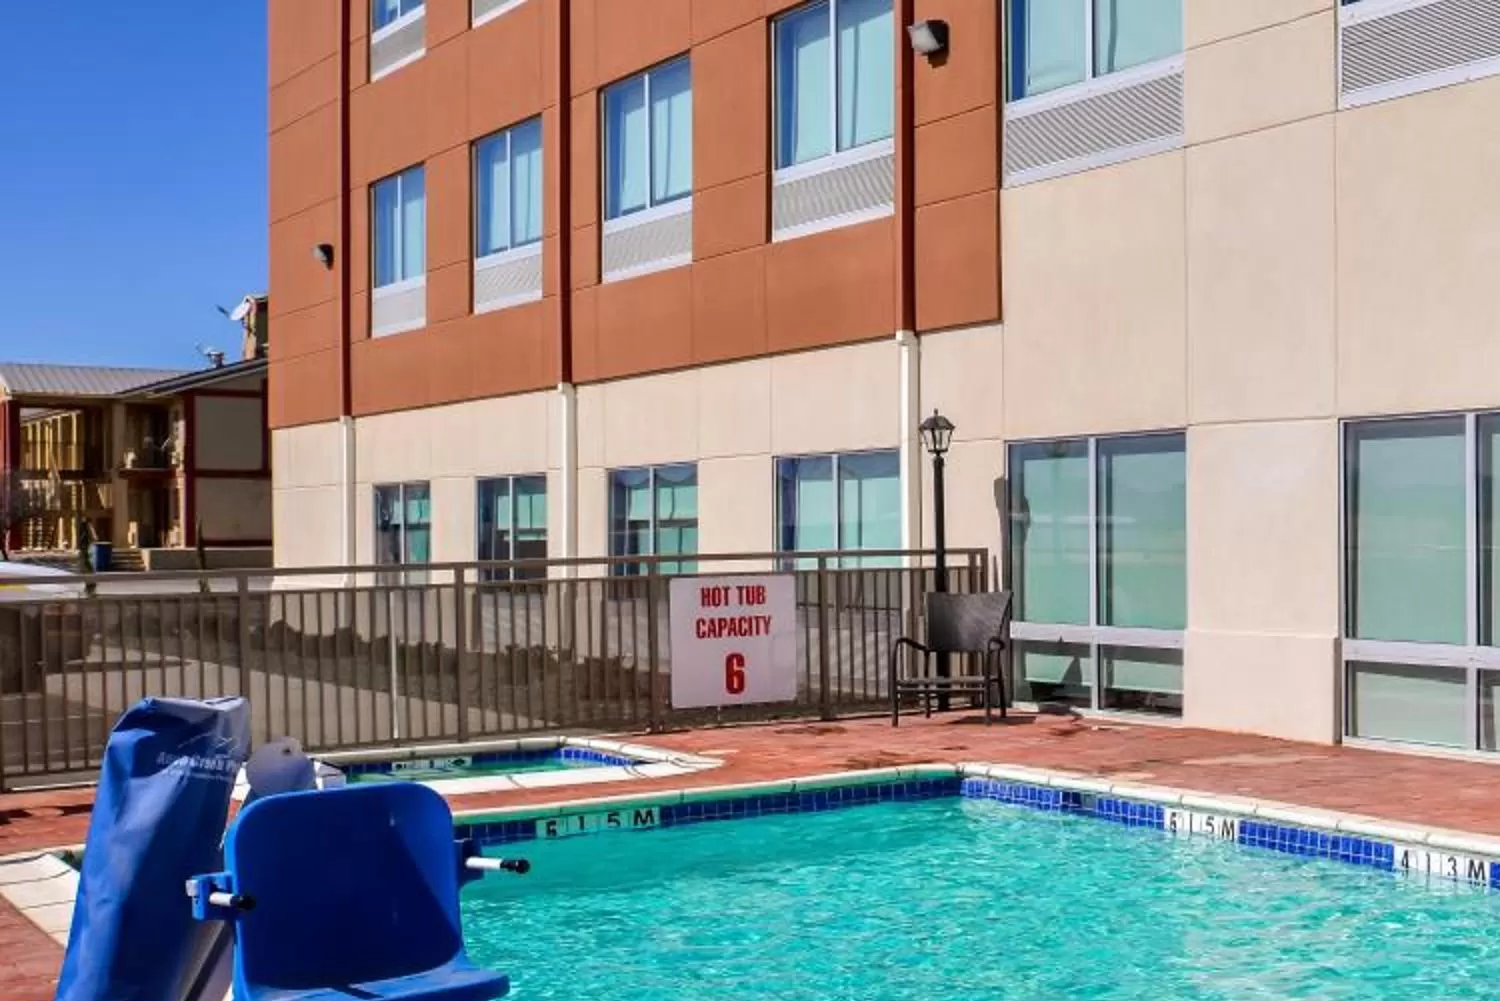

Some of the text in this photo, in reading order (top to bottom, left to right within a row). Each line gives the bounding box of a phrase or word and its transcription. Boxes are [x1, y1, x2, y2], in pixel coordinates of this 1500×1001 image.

[701, 585, 766, 607] HOT TUB
[696, 615, 771, 639] CAPACITY
[725, 653, 745, 694] 6
